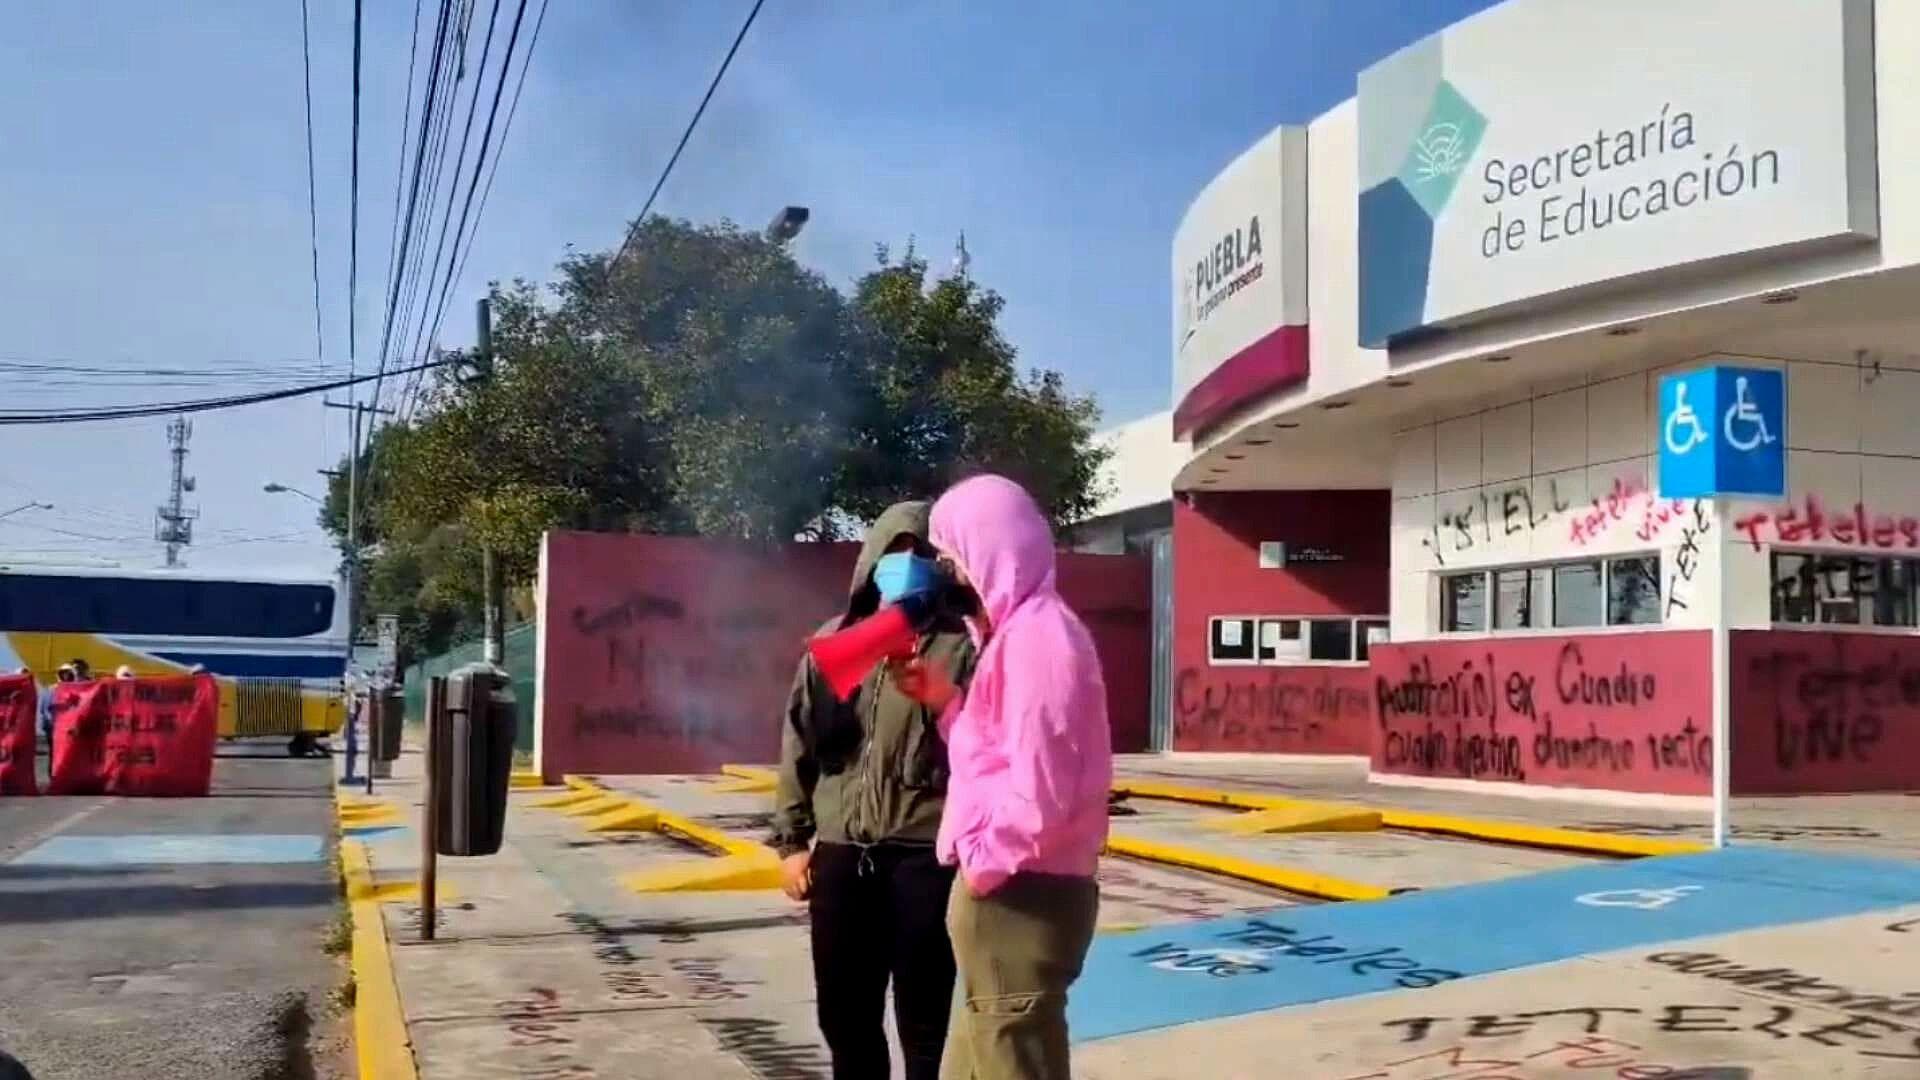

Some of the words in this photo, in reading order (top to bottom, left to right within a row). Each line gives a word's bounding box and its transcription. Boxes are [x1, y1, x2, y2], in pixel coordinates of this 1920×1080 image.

[1481, 211, 1526, 258] de
[1540, 144, 1779, 242] Educación
[1483, 102, 1697, 205] Secretaría
[1196, 215, 1262, 301] PUEBLA
